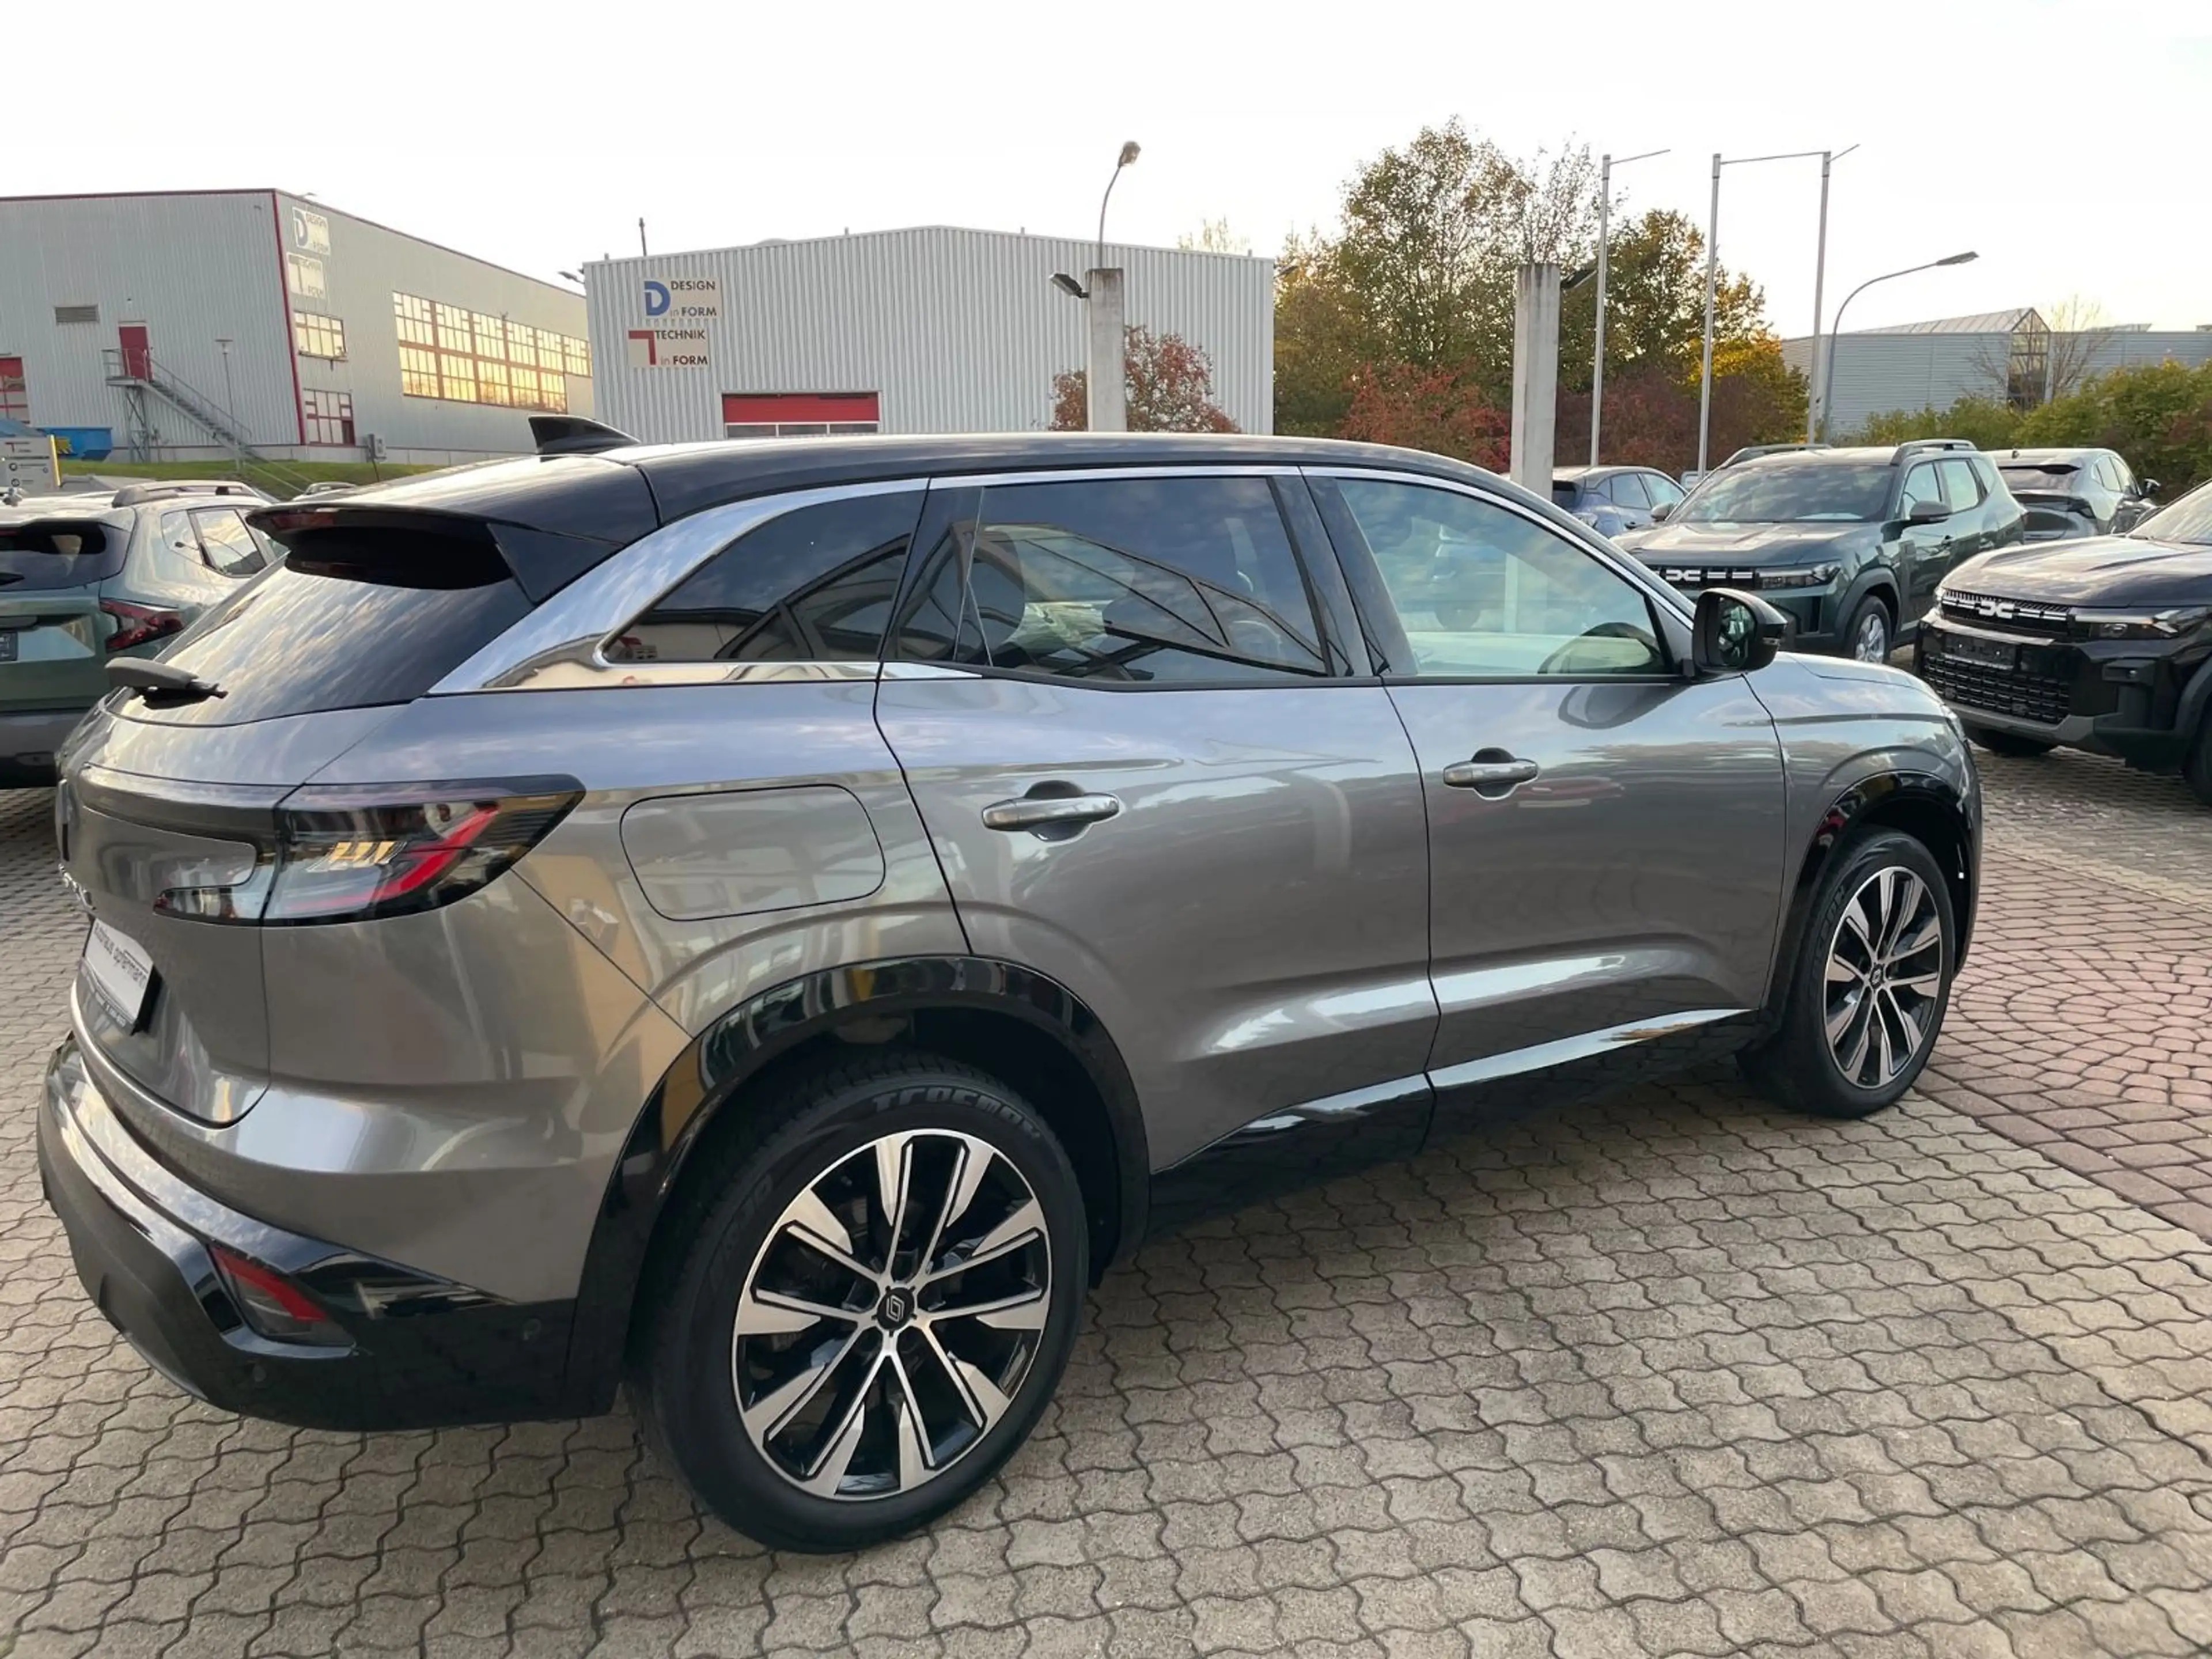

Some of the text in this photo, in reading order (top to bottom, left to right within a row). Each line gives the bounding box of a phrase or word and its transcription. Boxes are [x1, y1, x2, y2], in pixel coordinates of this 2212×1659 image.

[670, 281, 715, 290] DESIGN
[670, 306, 717, 316] in FORM
[656, 329, 705, 339] TECHNIK
[661, 355, 708, 365] in FORM
